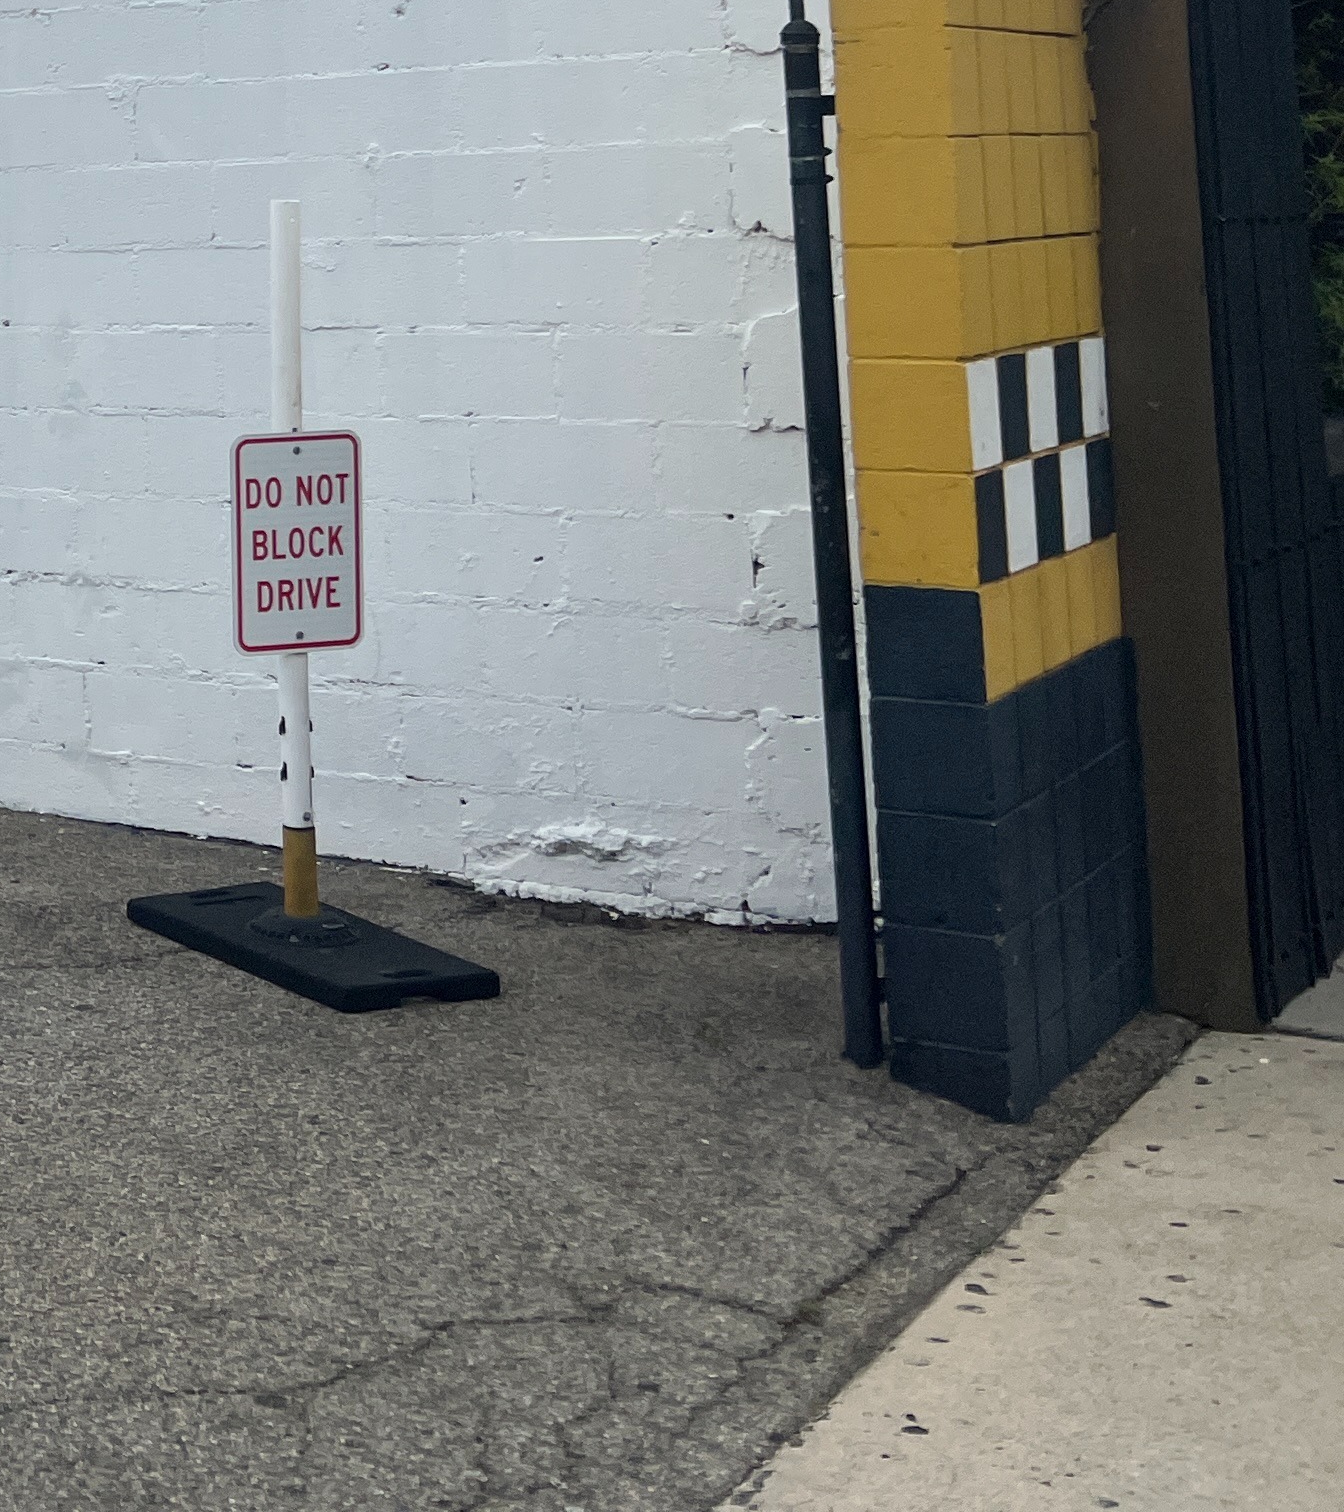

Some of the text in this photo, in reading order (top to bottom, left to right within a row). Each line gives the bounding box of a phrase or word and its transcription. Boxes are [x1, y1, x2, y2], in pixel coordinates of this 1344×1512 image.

[245, 473, 349, 510] DO NOT
[252, 525, 344, 561] BLOCK
[257, 576, 341, 613] DRIVE
